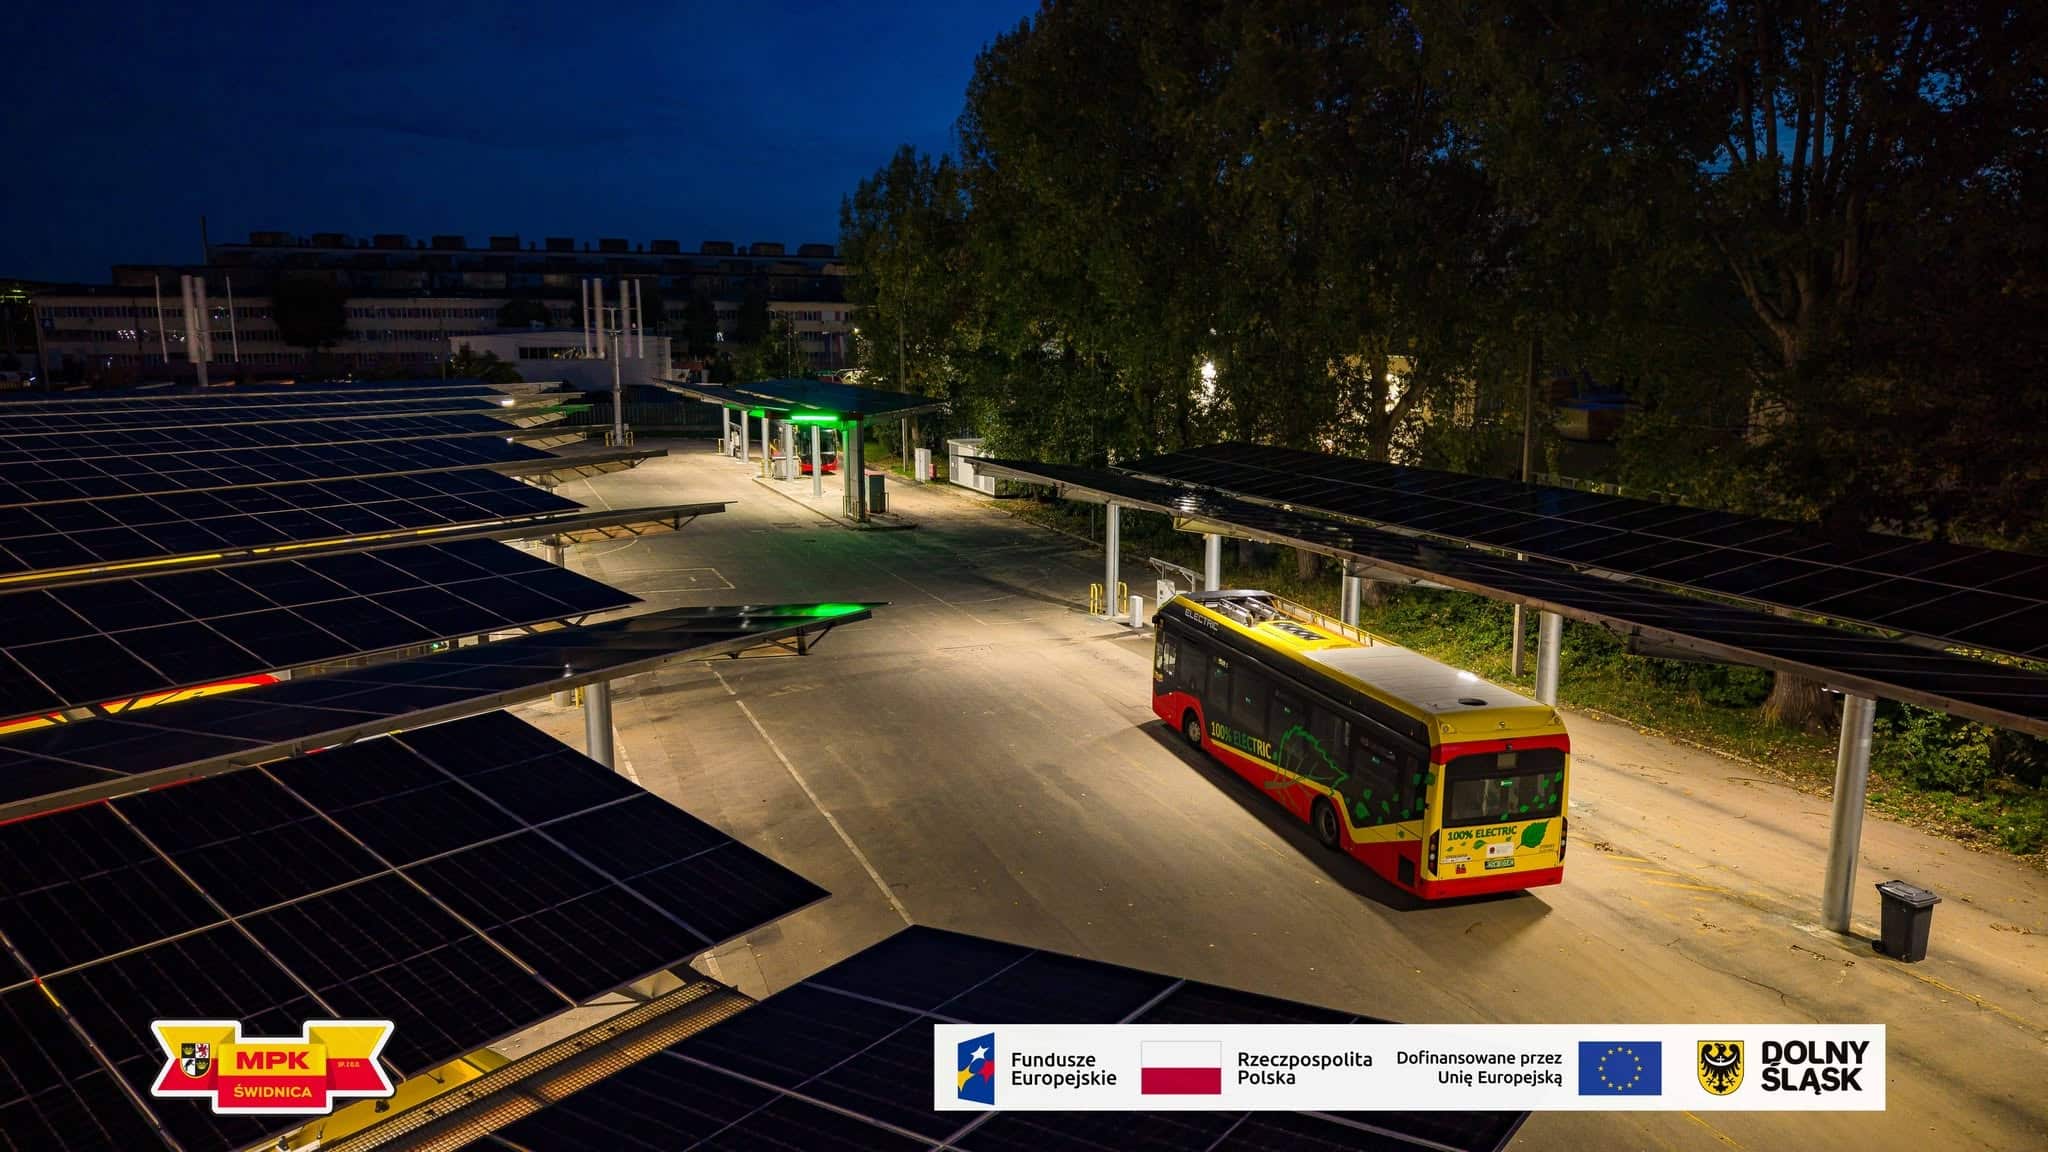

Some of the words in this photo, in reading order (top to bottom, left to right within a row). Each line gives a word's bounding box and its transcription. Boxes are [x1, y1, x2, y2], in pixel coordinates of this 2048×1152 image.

[1184, 608, 1219, 632] ELECTRIC
[1210, 721, 1233, 742] 100%
[1233, 730, 1272, 760] ELECTRIC
[1447, 830, 1473, 841] 100%
[1475, 825, 1518, 838] ELECTRIC
